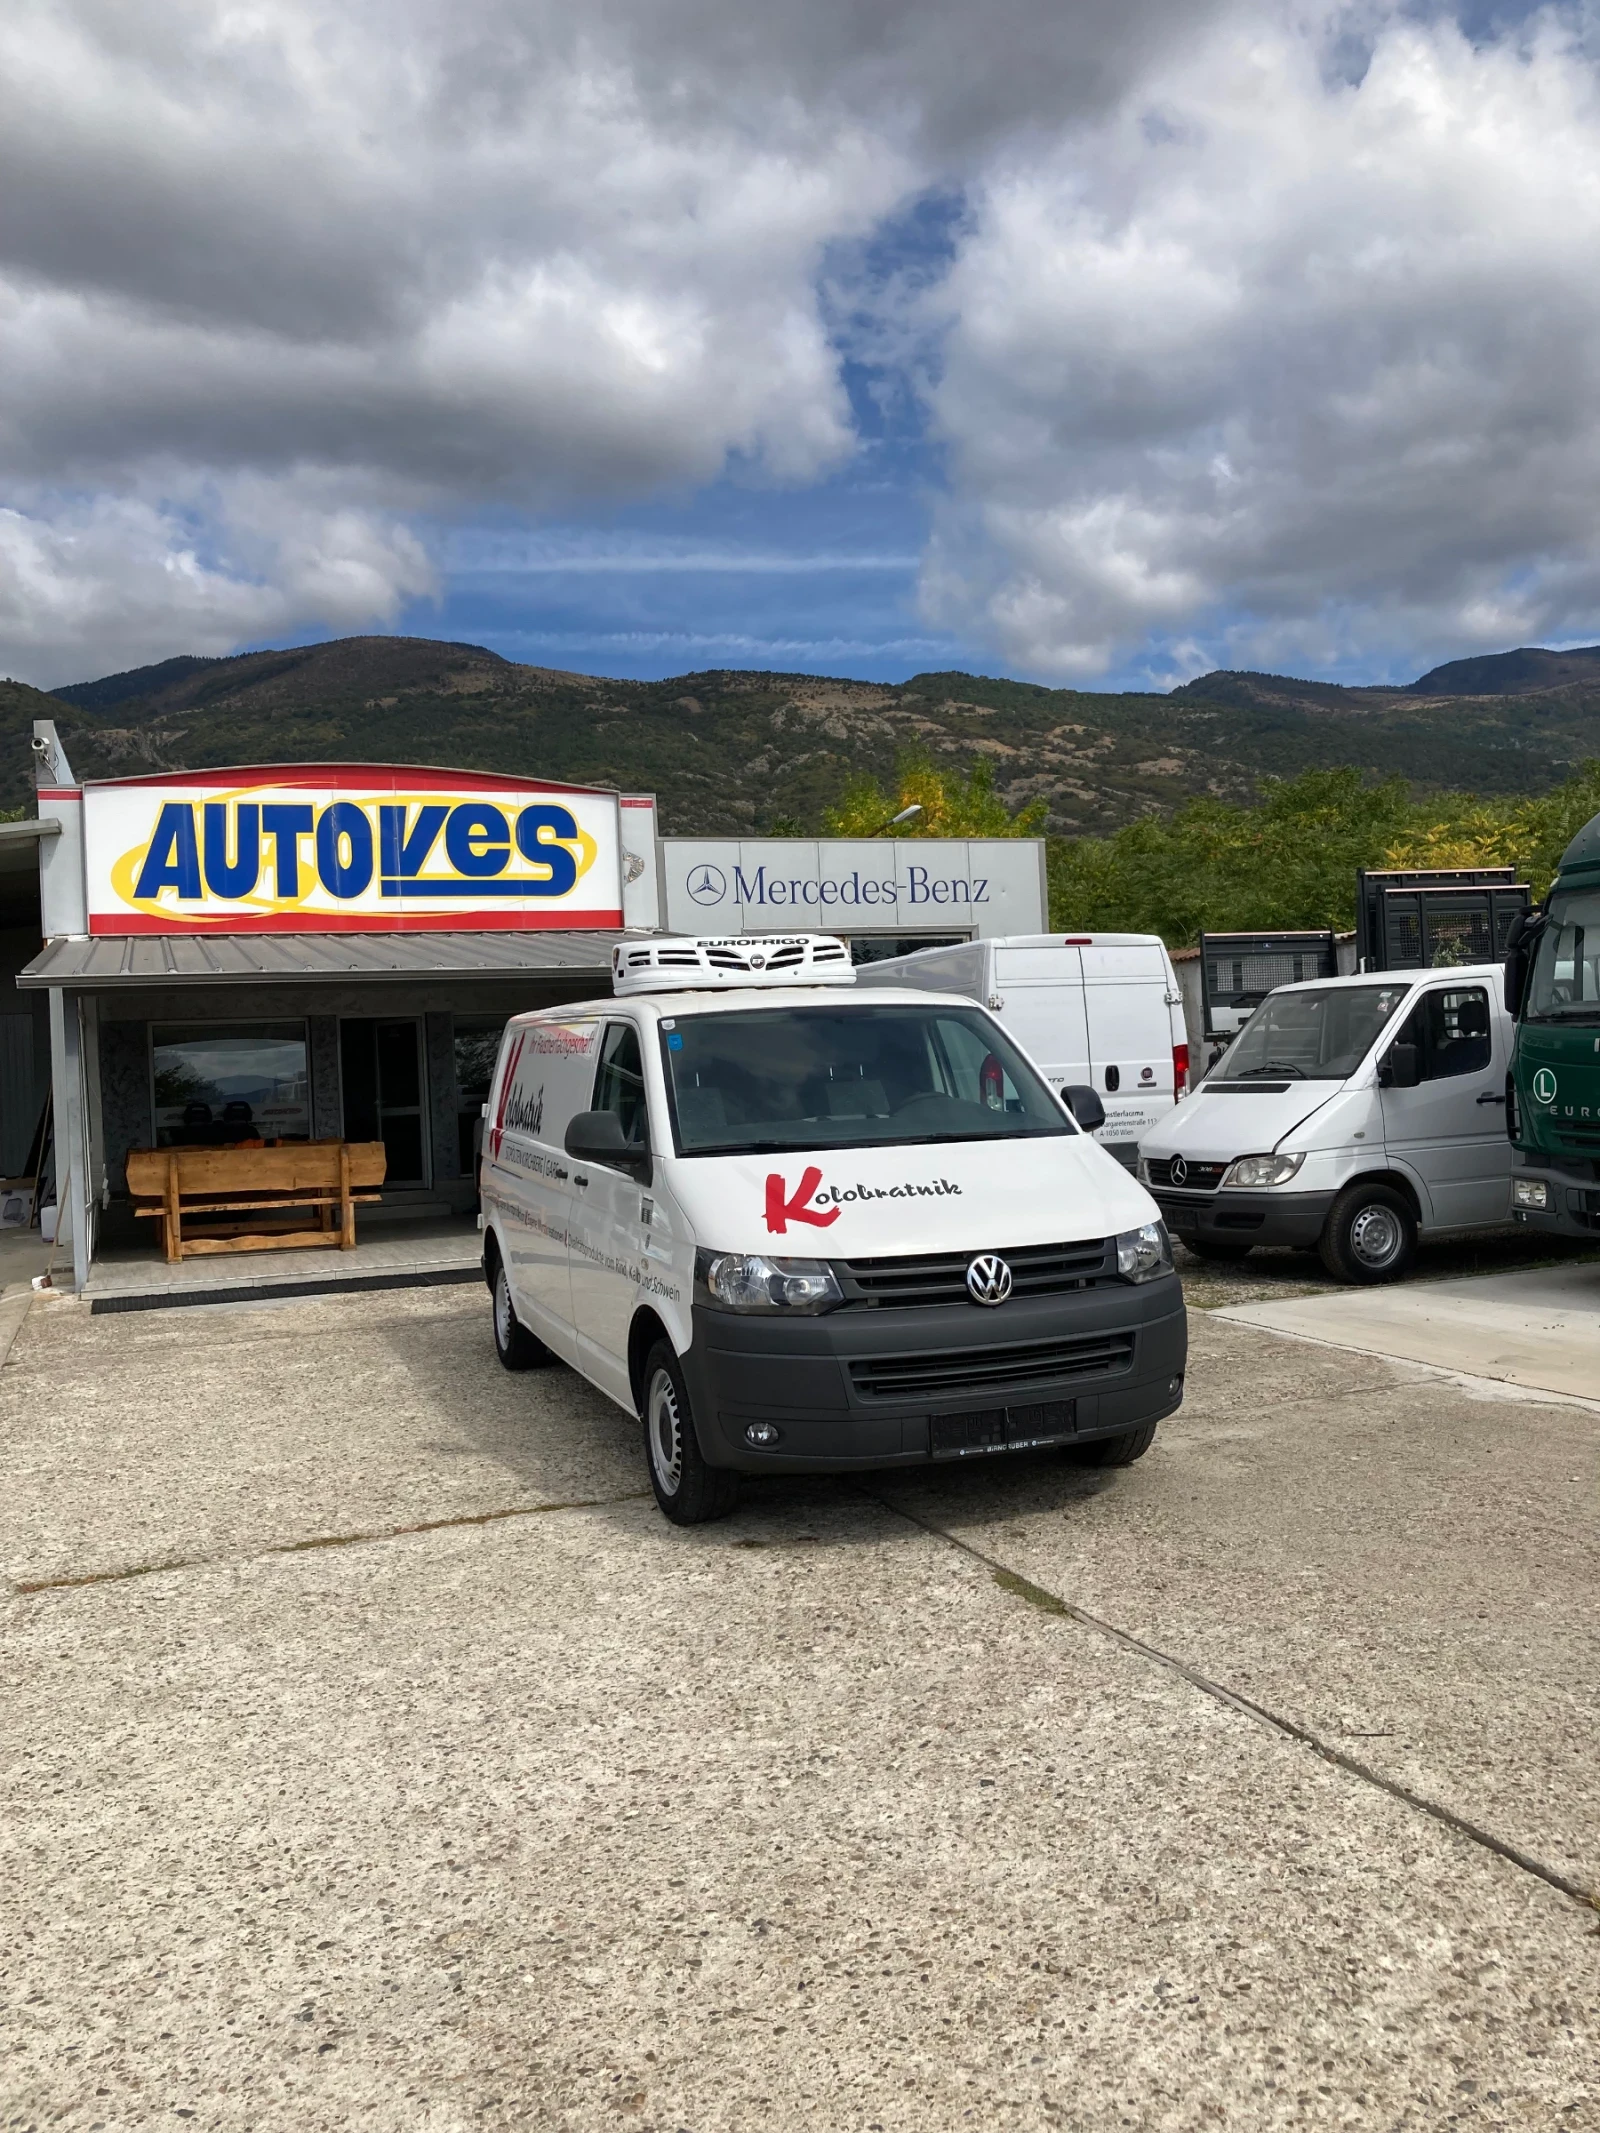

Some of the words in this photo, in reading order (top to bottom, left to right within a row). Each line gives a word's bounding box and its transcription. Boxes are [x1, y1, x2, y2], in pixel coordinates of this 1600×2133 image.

[732, 866, 990, 905] Mercedes-Benz
[697, 938, 810, 947] EUROFRIGO
[1549, 1105, 1600, 1117] EUR
[761, 1166, 963, 1234] Kolobratnik
[651, 1276, 680, 1302] Schwein
